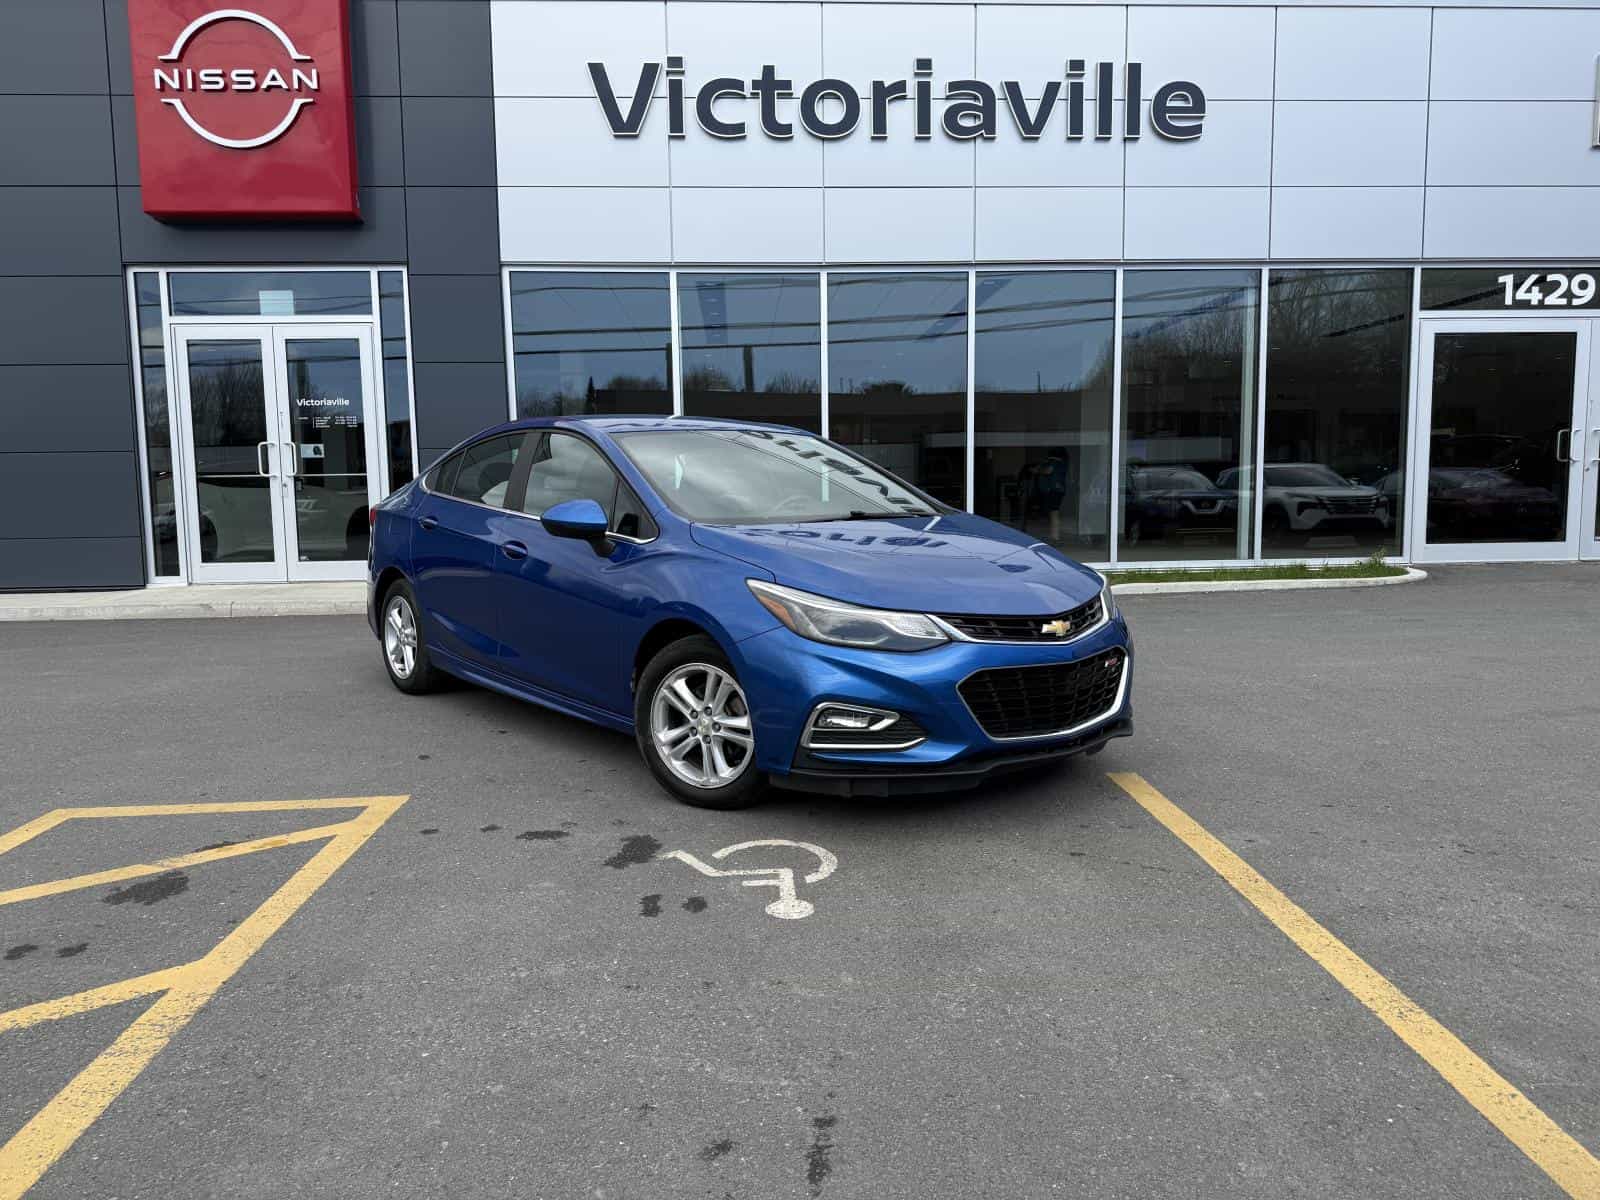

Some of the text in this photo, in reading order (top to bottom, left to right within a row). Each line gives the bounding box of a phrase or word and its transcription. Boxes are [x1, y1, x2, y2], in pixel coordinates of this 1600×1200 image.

[153, 68, 319, 90] NISSAN
[585, 56, 1207, 140] Victoriaville
[1497, 273, 1596, 306] 1429
[296, 398, 350, 407] Victoriaville
